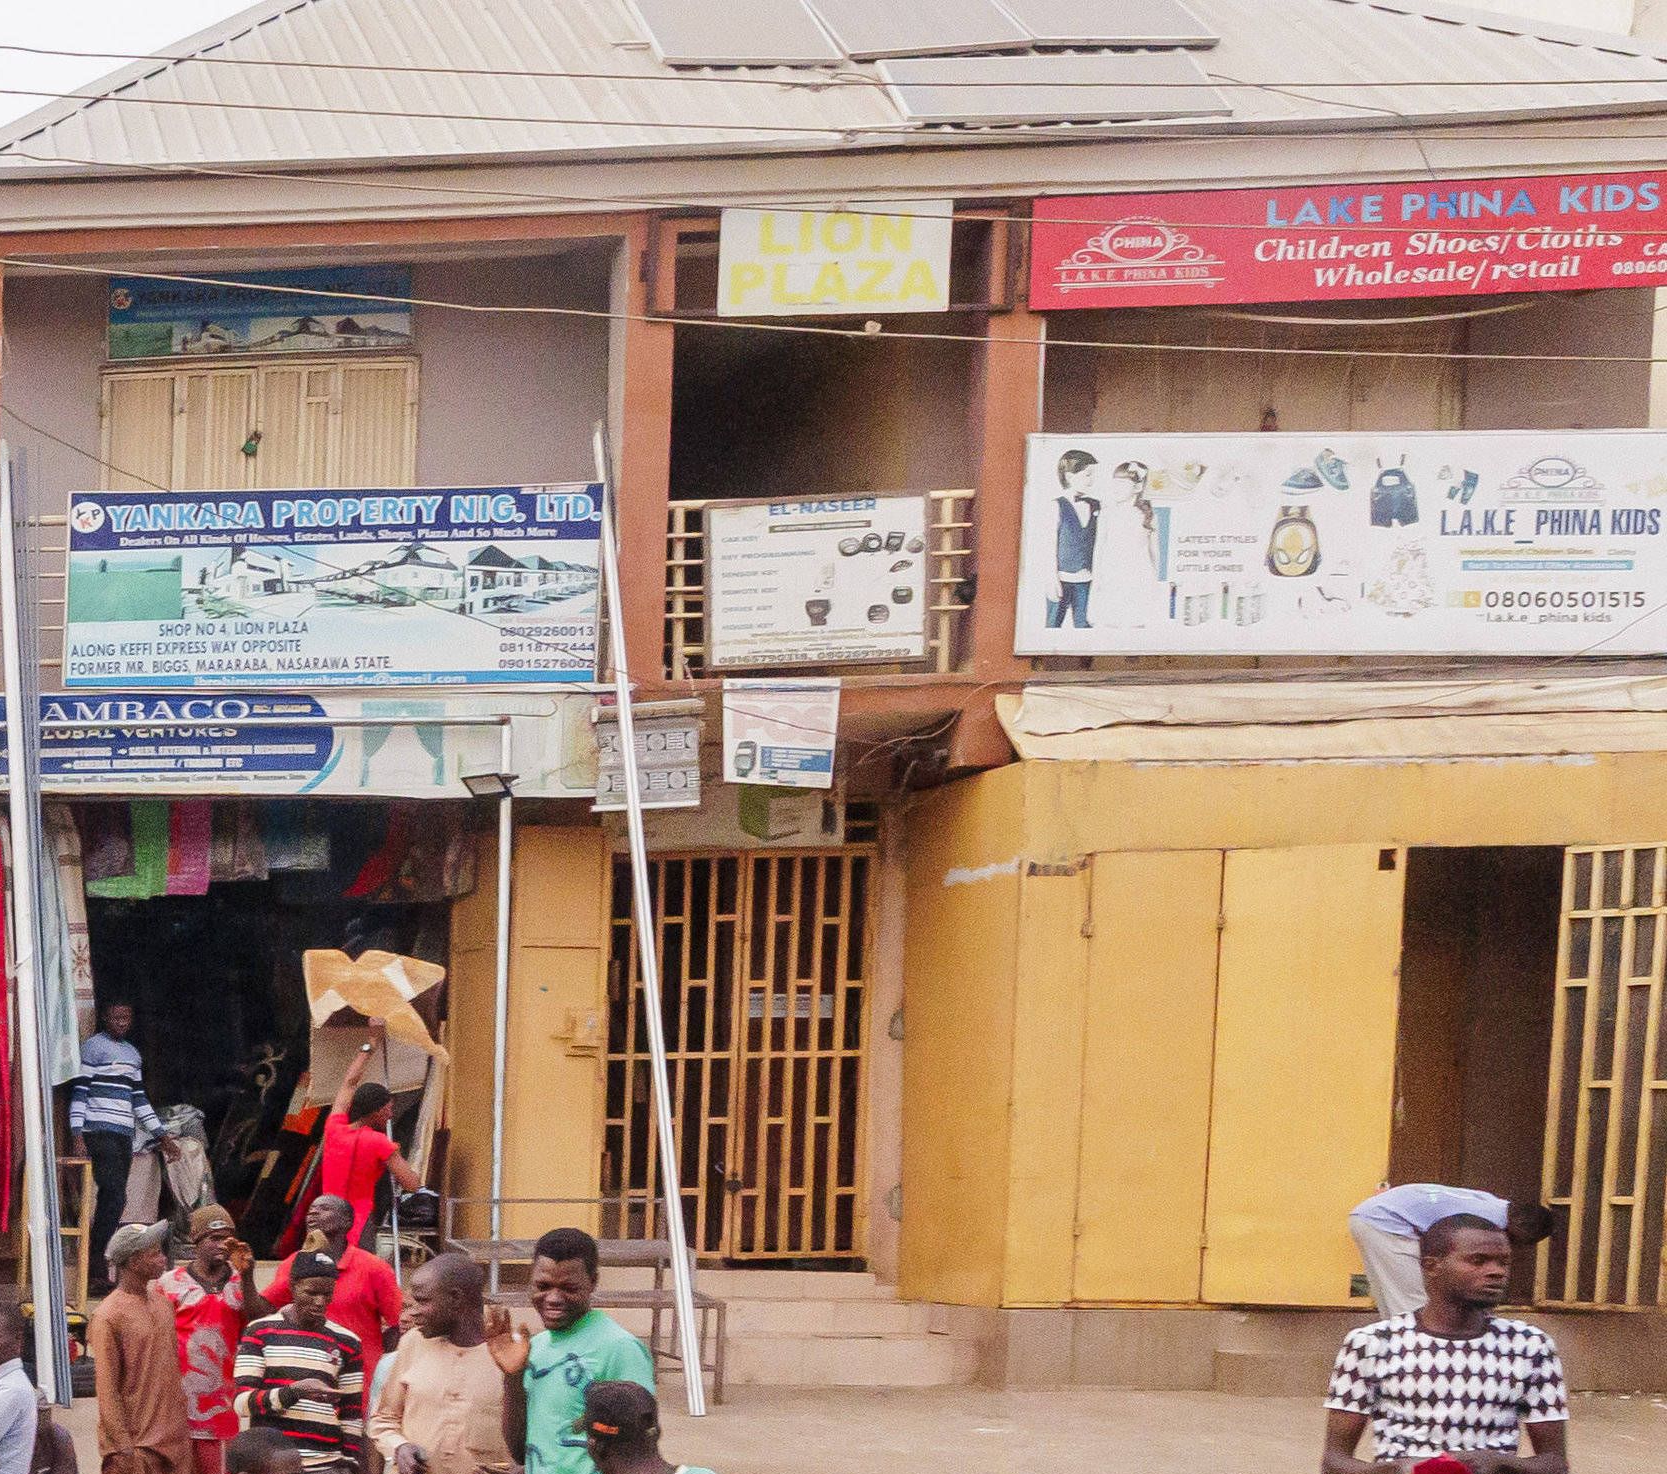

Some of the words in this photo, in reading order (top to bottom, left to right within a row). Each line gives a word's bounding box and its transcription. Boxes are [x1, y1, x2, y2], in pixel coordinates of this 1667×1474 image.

[1267, 194, 1384, 227] LAKE
[1401, 189, 1537, 220] PHINA
[1560, 182, 1660, 214] KIDS
[760, 212, 913, 255] LION
[1113, 236, 1164, 250] PHINA
[1254, 235, 1392, 263] Children
[1314, 255, 1581, 289] Wholesale/retail
[730, 259, 939, 305] PLAZA
[106, 501, 265, 532] YANKARA
[272, 496, 443, 528] PROPERTY
[450, 494, 527, 523] NIG.
[536, 494, 602, 522] LTD.
[769, 498, 876, 516] EL-NASEER
[1611, 509, 1661, 536] KIDS
[120, 536, 161, 546] Dealers
[164, 535, 180, 544] On
[451, 528, 474, 538] And
[476, 528, 491, 538] So
[493, 528, 525, 538] Much
[527, 528, 558, 538] More
[1485, 591, 1645, 607] 08060501515
[158, 623, 191, 637] SHOP
[196, 623, 215, 636] NO
[235, 621, 264, 635] LION
[269, 620, 309, 634] PLAZA
[70, 643, 116, 657] ALONG
[120, 642, 152, 656] KEFFI
[156, 641, 207, 655] EXPRESS
[211, 640, 238, 653] WAY
[242, 639, 301, 653] OPPOSITE
[70, 661, 121, 675] FORMER
[276, 657, 351, 671] NASARAWA
[41, 700, 249, 721] AMBACO
[42, 726, 116, 740] LOBAL
